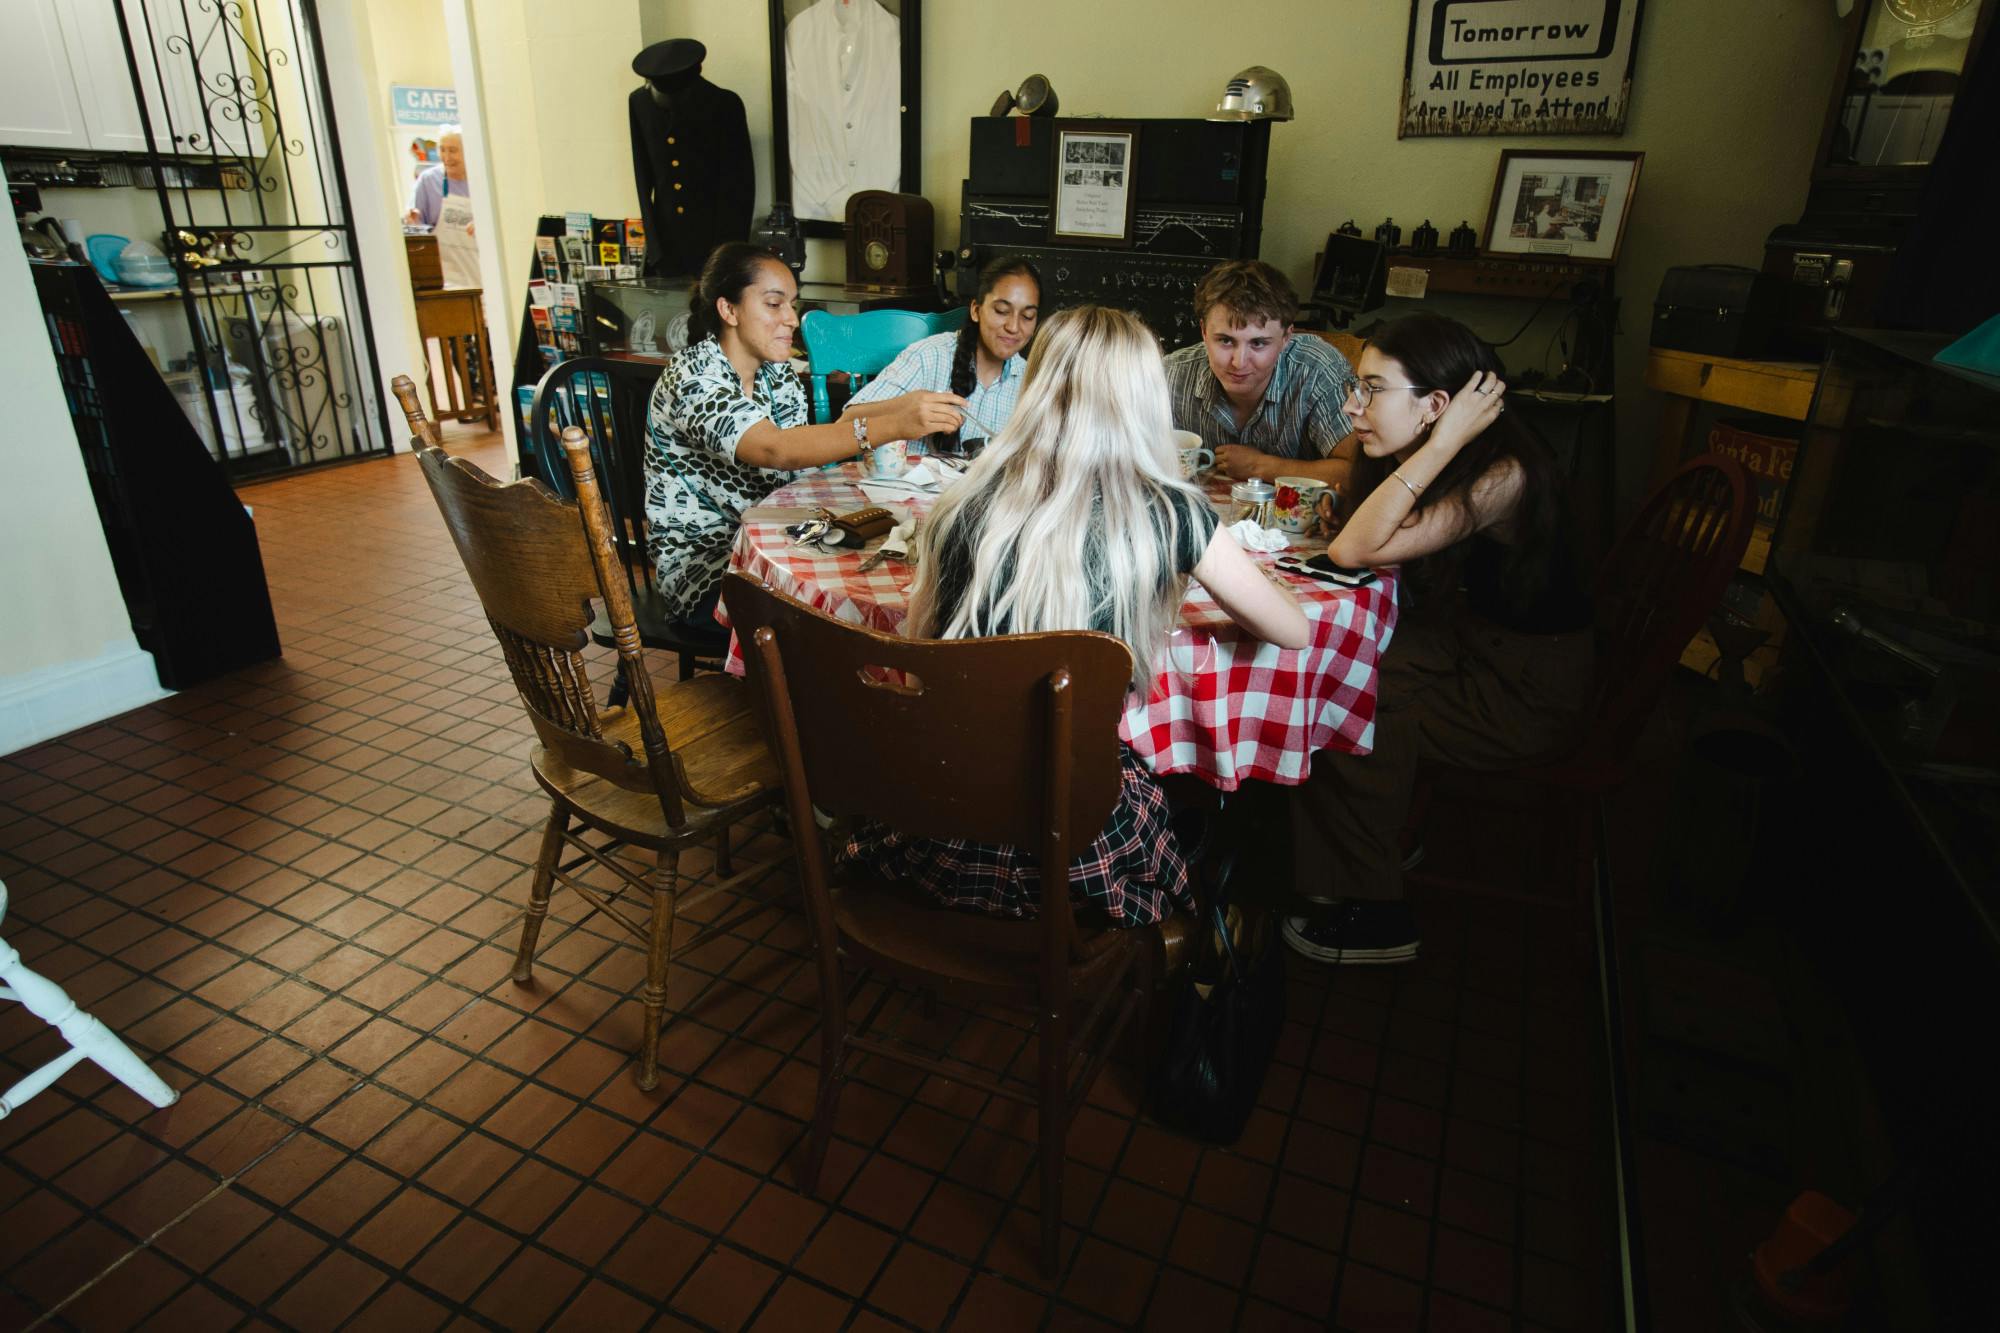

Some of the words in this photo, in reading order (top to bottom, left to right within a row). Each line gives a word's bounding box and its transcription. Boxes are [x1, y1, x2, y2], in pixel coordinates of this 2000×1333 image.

[1450, 19, 1590, 43] Tomorrow
[1429, 69, 1460, 91] All
[1469, 68, 1600, 97] Employees
[406, 90, 457, 109] CAFE
[1417, 101, 1447, 119] Are
[1510, 97, 1532, 119] To
[1534, 95, 1610, 118] Attend
